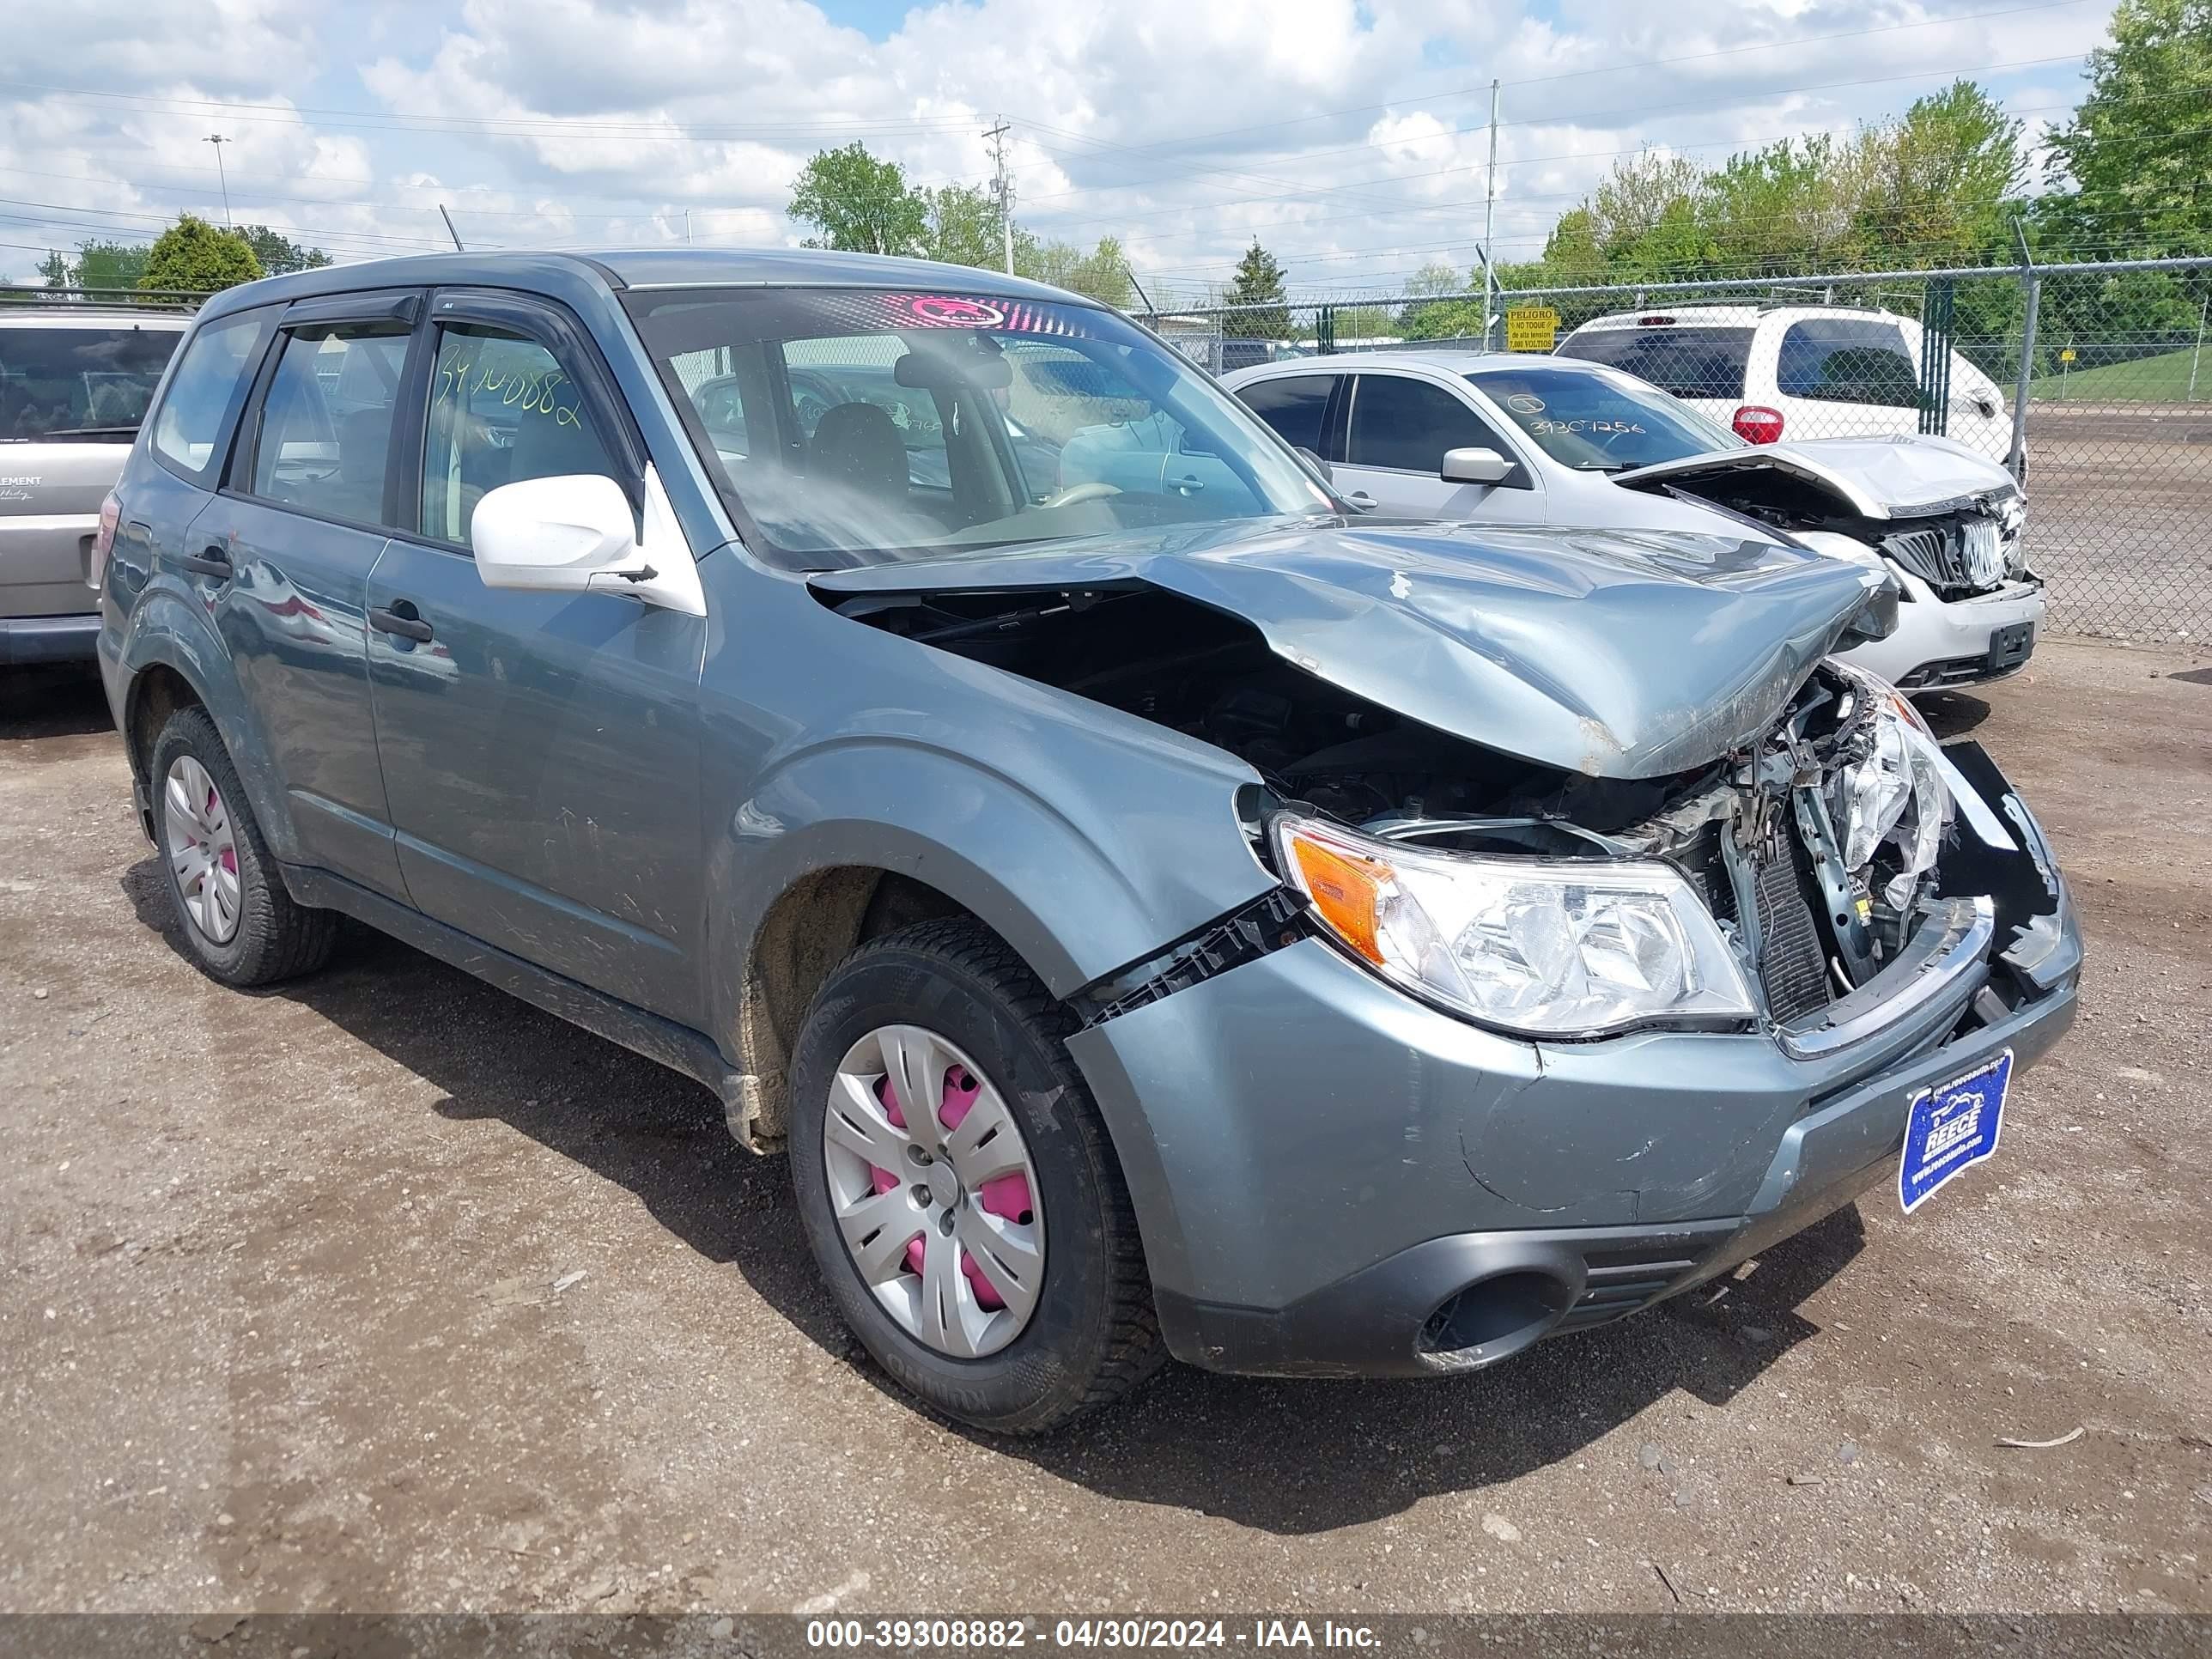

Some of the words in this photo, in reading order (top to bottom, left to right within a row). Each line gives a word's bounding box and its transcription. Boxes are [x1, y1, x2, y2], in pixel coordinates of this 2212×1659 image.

[1510, 310, 1553, 319] PELIGRO
[1924, 1109, 1982, 1153] REECE
[1911, 1134, 1984, 1185] www.reeceauto.com
